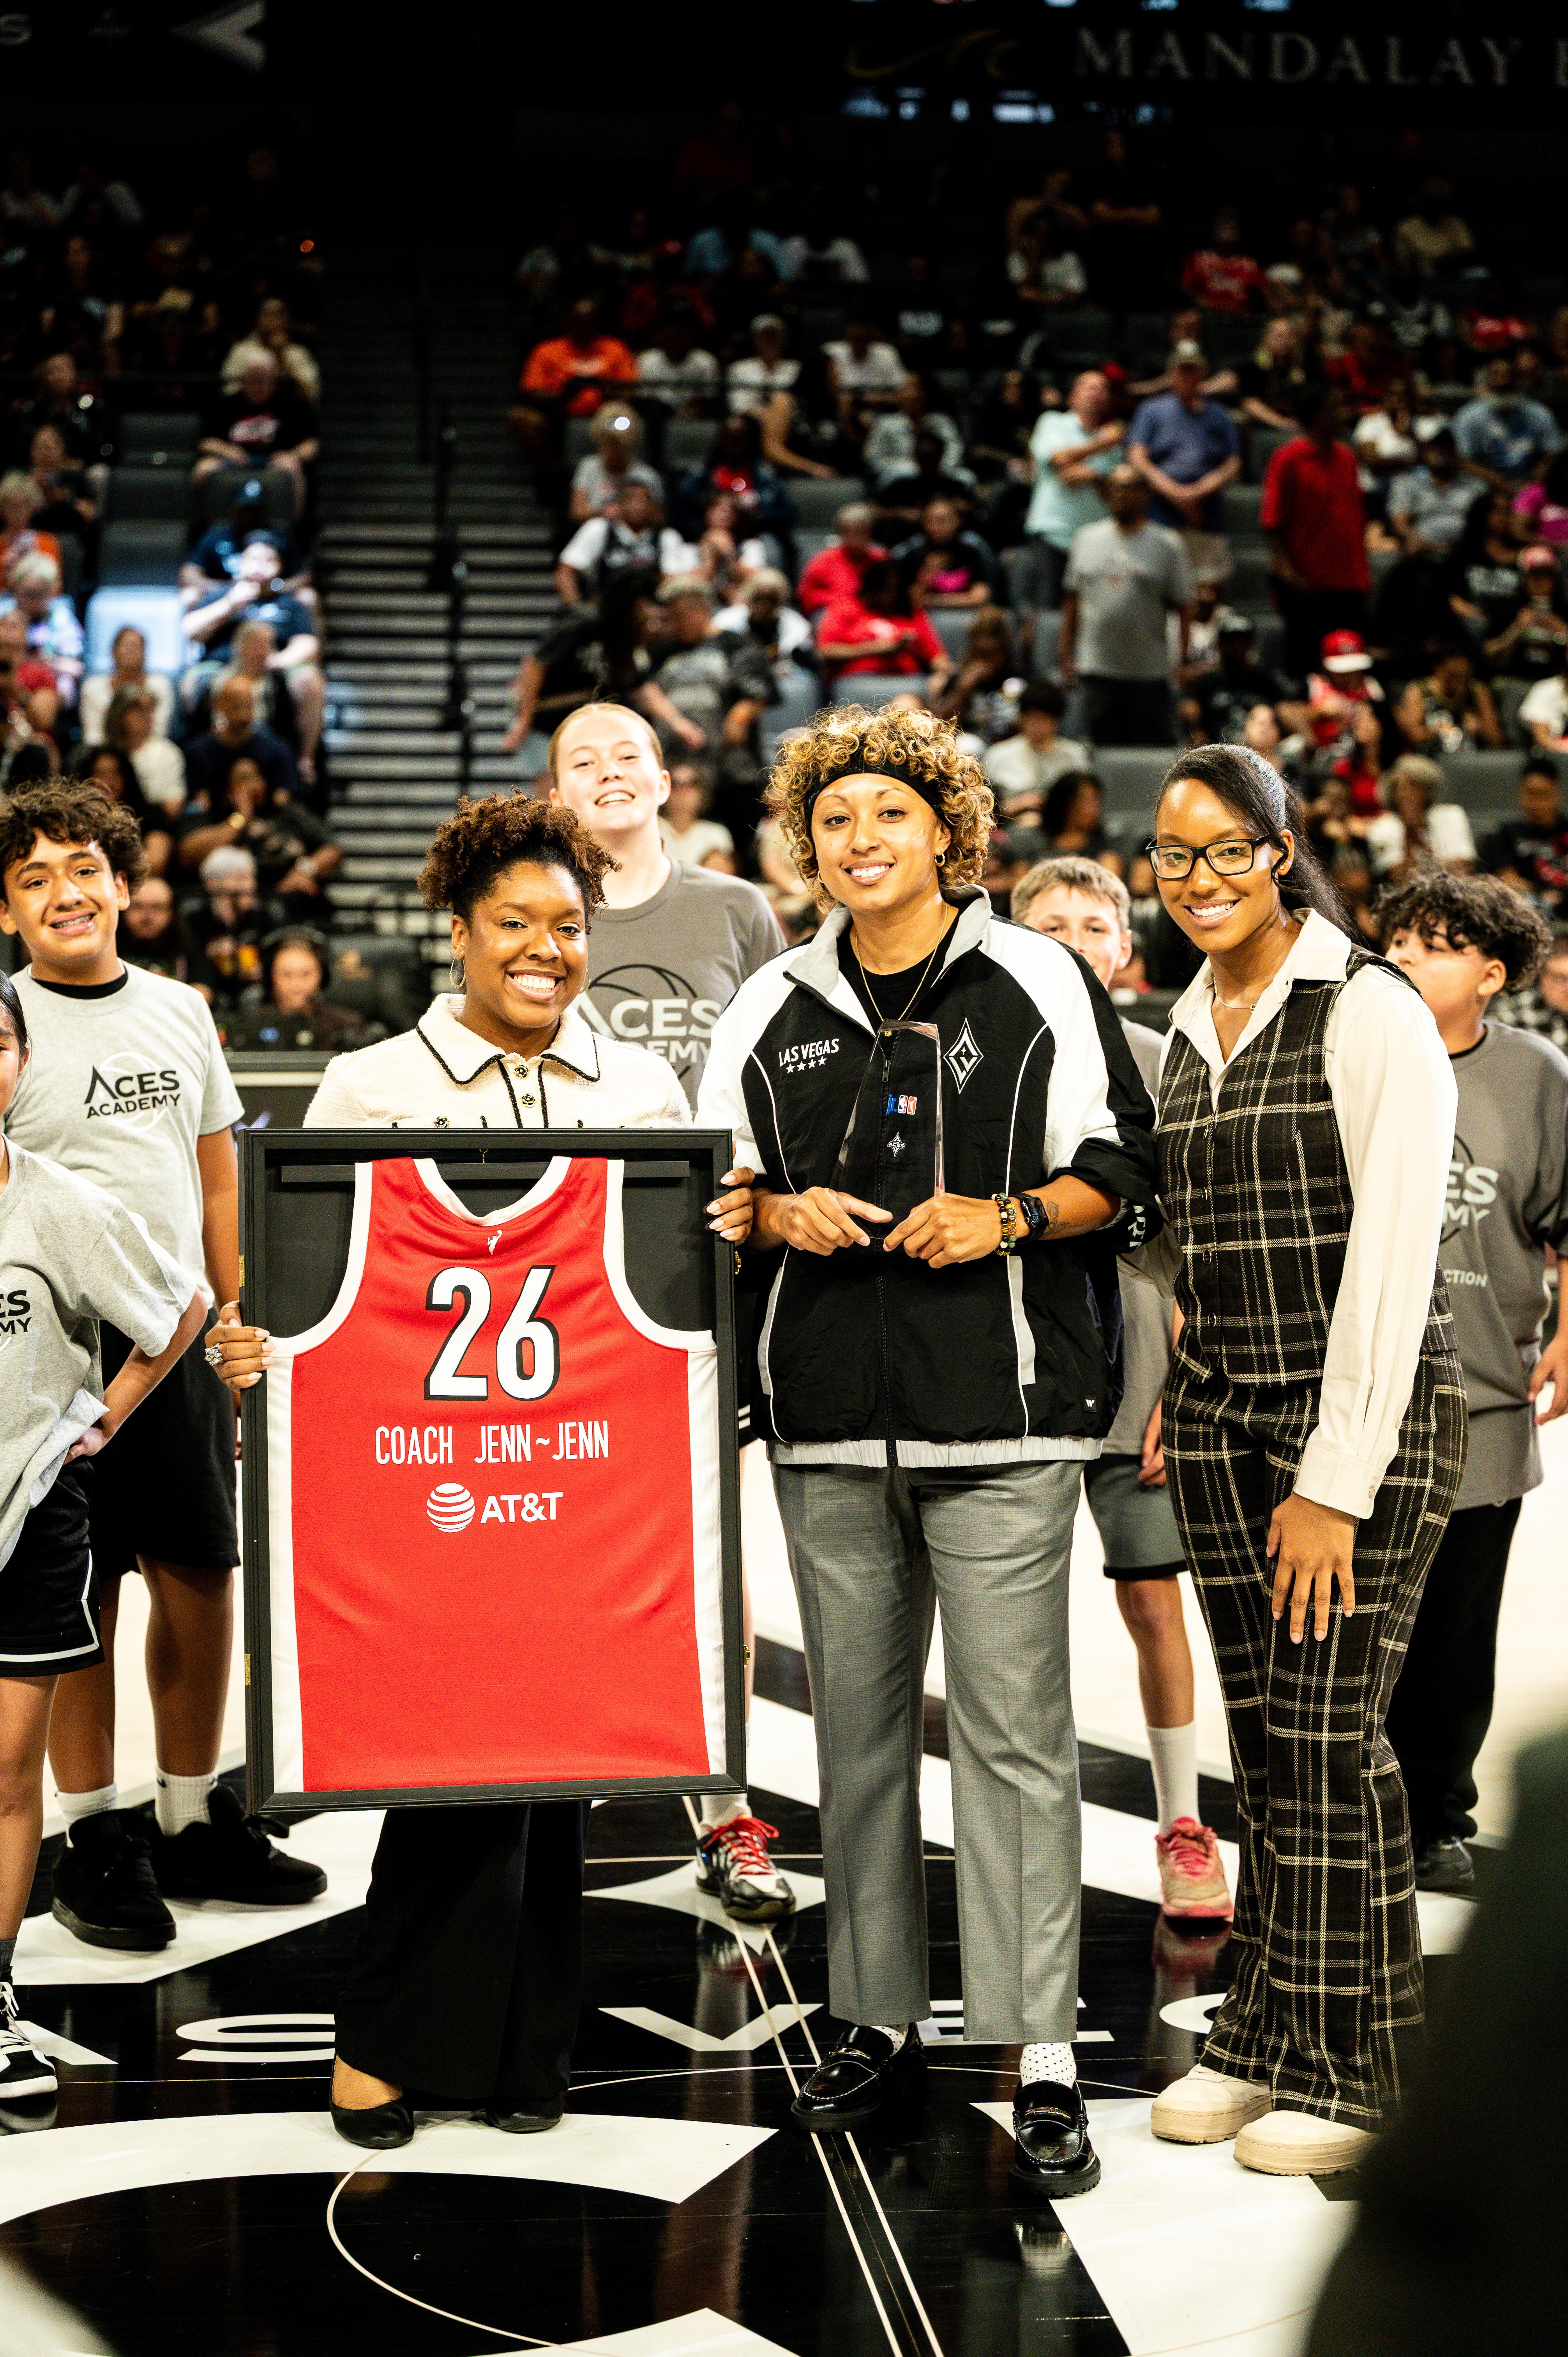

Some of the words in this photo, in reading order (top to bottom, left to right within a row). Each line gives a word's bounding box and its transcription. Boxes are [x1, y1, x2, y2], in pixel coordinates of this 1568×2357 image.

[1072, 25, 1523, 88] MANDALAY
[779, 1046, 799, 1067] LAS
[801, 1038, 839, 1059] VEGAS
[84, 1065, 180, 1104] ACES
[87, 1094, 181, 1118] ACADEMY
[424, 1265, 560, 1401] 26
[375, 1426, 453, 1465] COACH
[480, 1491, 563, 1524] AT&T
